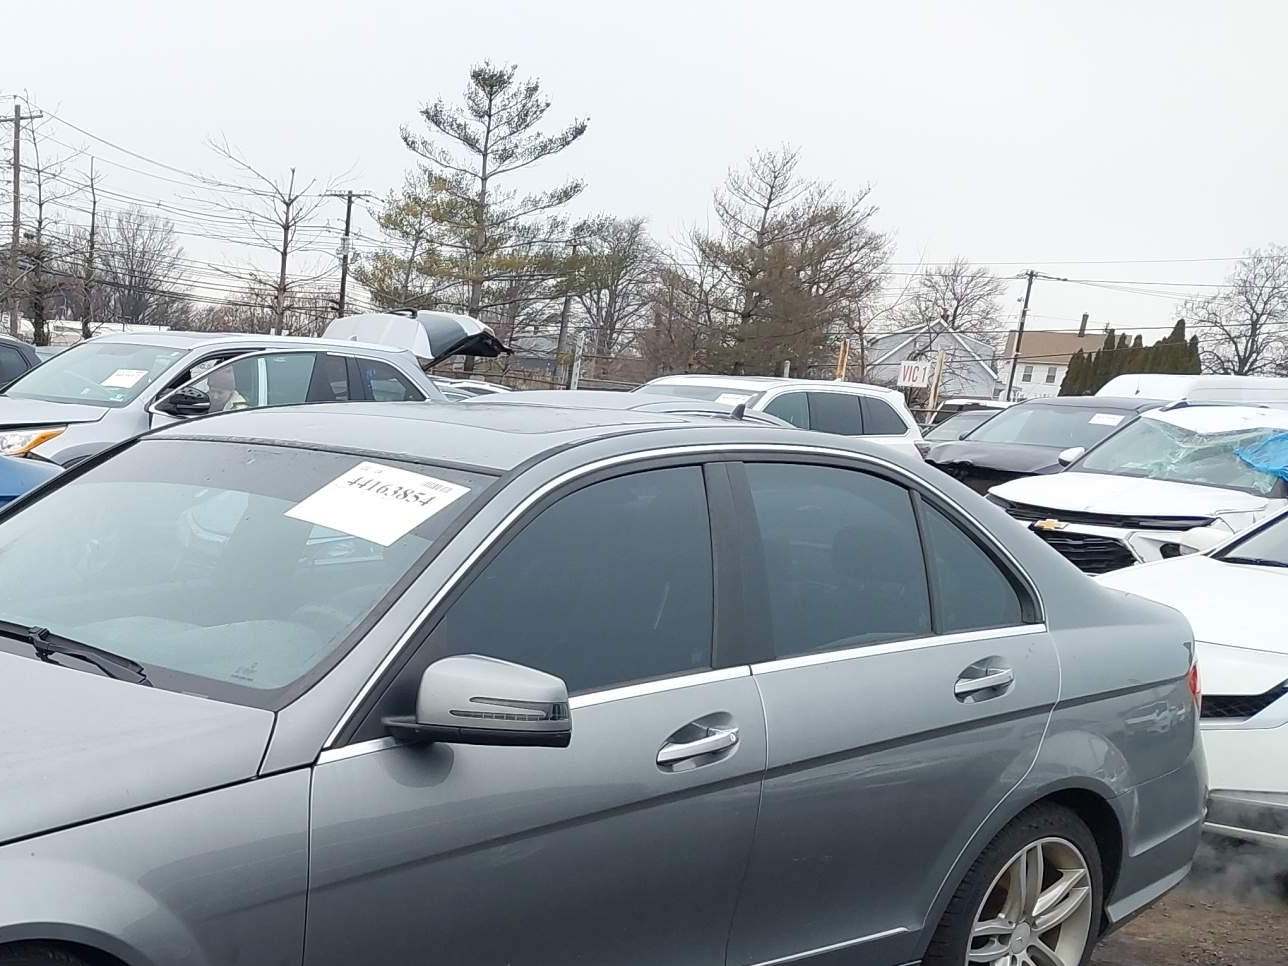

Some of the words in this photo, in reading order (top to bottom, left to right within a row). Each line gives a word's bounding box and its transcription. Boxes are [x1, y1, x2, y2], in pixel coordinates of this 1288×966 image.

[903, 365, 919, 382] VIC
[922, 366, 928, 382] 1
[347, 476, 436, 506] 44163854
